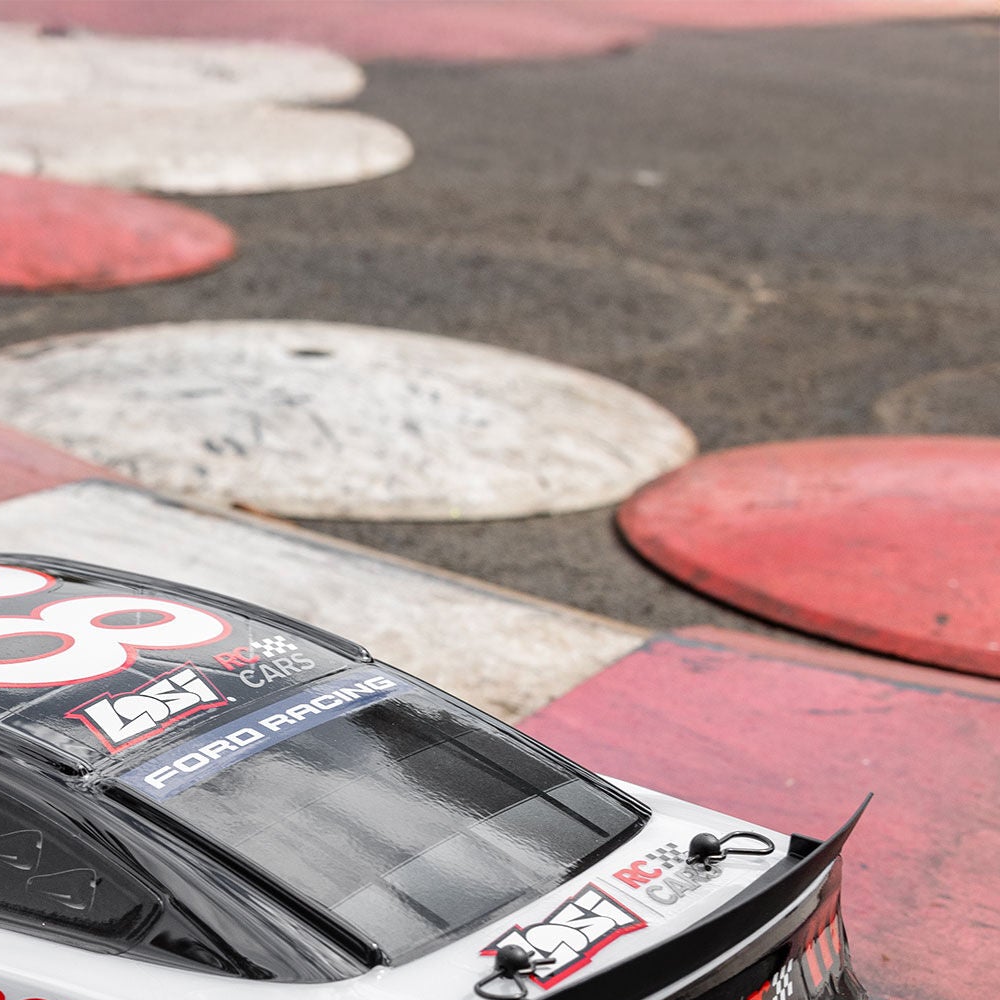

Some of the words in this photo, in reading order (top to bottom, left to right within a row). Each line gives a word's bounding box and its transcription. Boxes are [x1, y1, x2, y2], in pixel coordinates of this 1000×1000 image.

[214, 646, 260, 671] RC
[239, 653, 315, 688] CARS
[144, 728, 265, 789] FORD
[258, 675, 398, 732] RACING
[613, 860, 663, 889] RC
